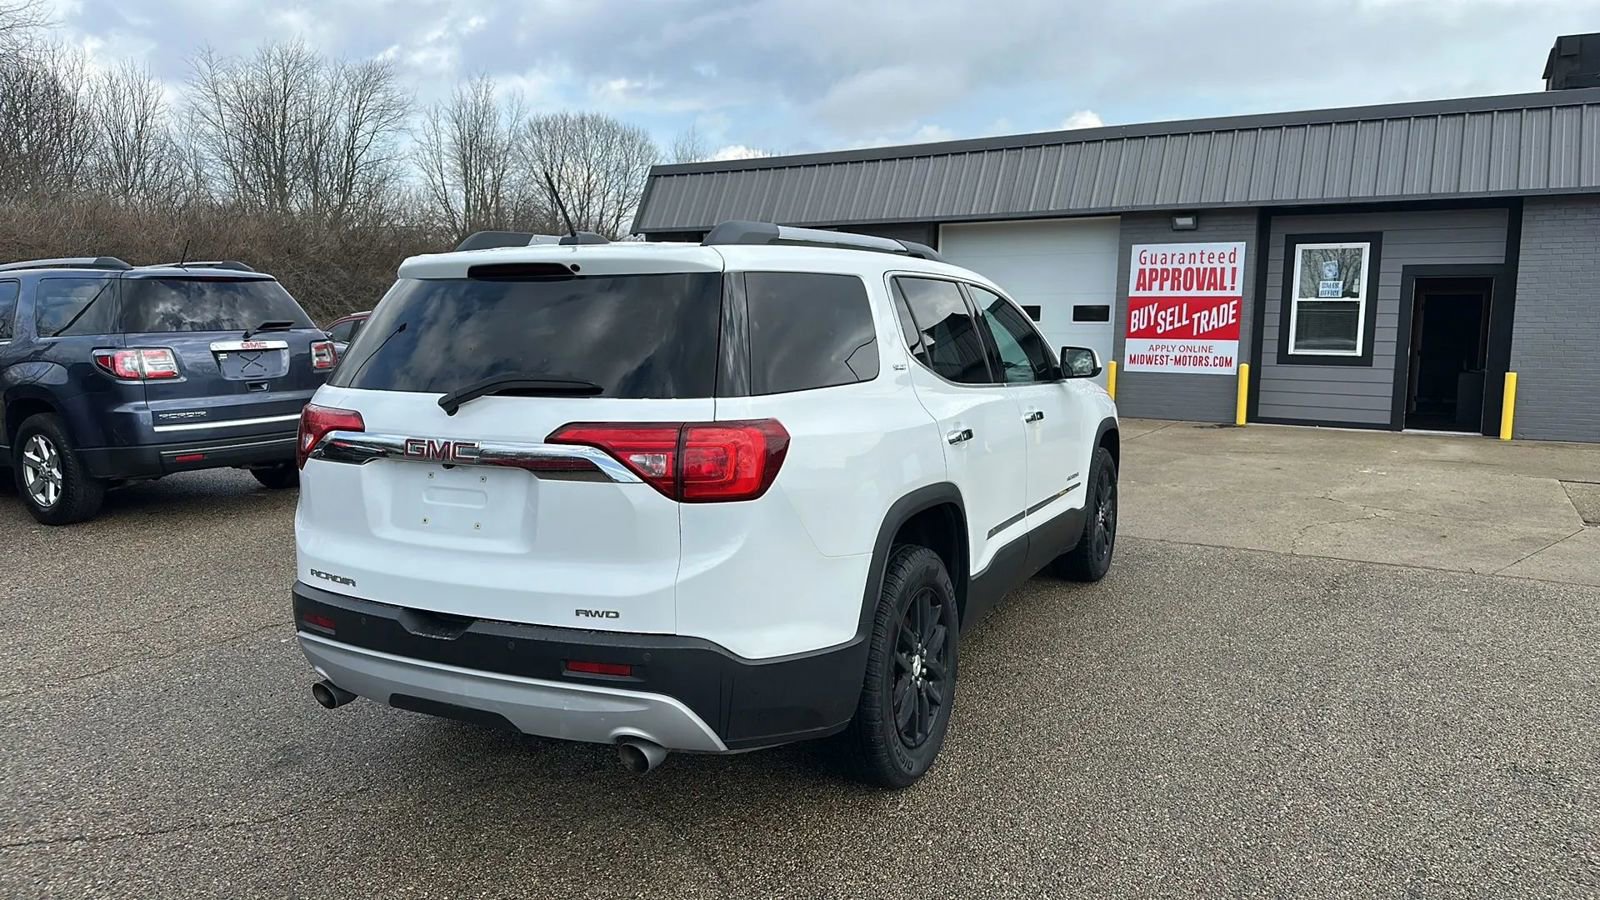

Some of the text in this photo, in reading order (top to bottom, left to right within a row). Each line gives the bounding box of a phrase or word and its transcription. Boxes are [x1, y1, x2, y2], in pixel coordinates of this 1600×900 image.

[1139, 247, 1237, 265] Guaranteed
[1135, 267, 1237, 291] APPROVAL!
[1130, 300, 1238, 336] BUY SELL TRADE
[1148, 344, 1214, 353] APPLY ONLINE
[1129, 354, 1233, 367] MIDWEST-MOTORS.COM
[404, 438, 480, 464] GMC
[310, 568, 356, 587] ACADIA
[575, 609, 620, 618] AWD
